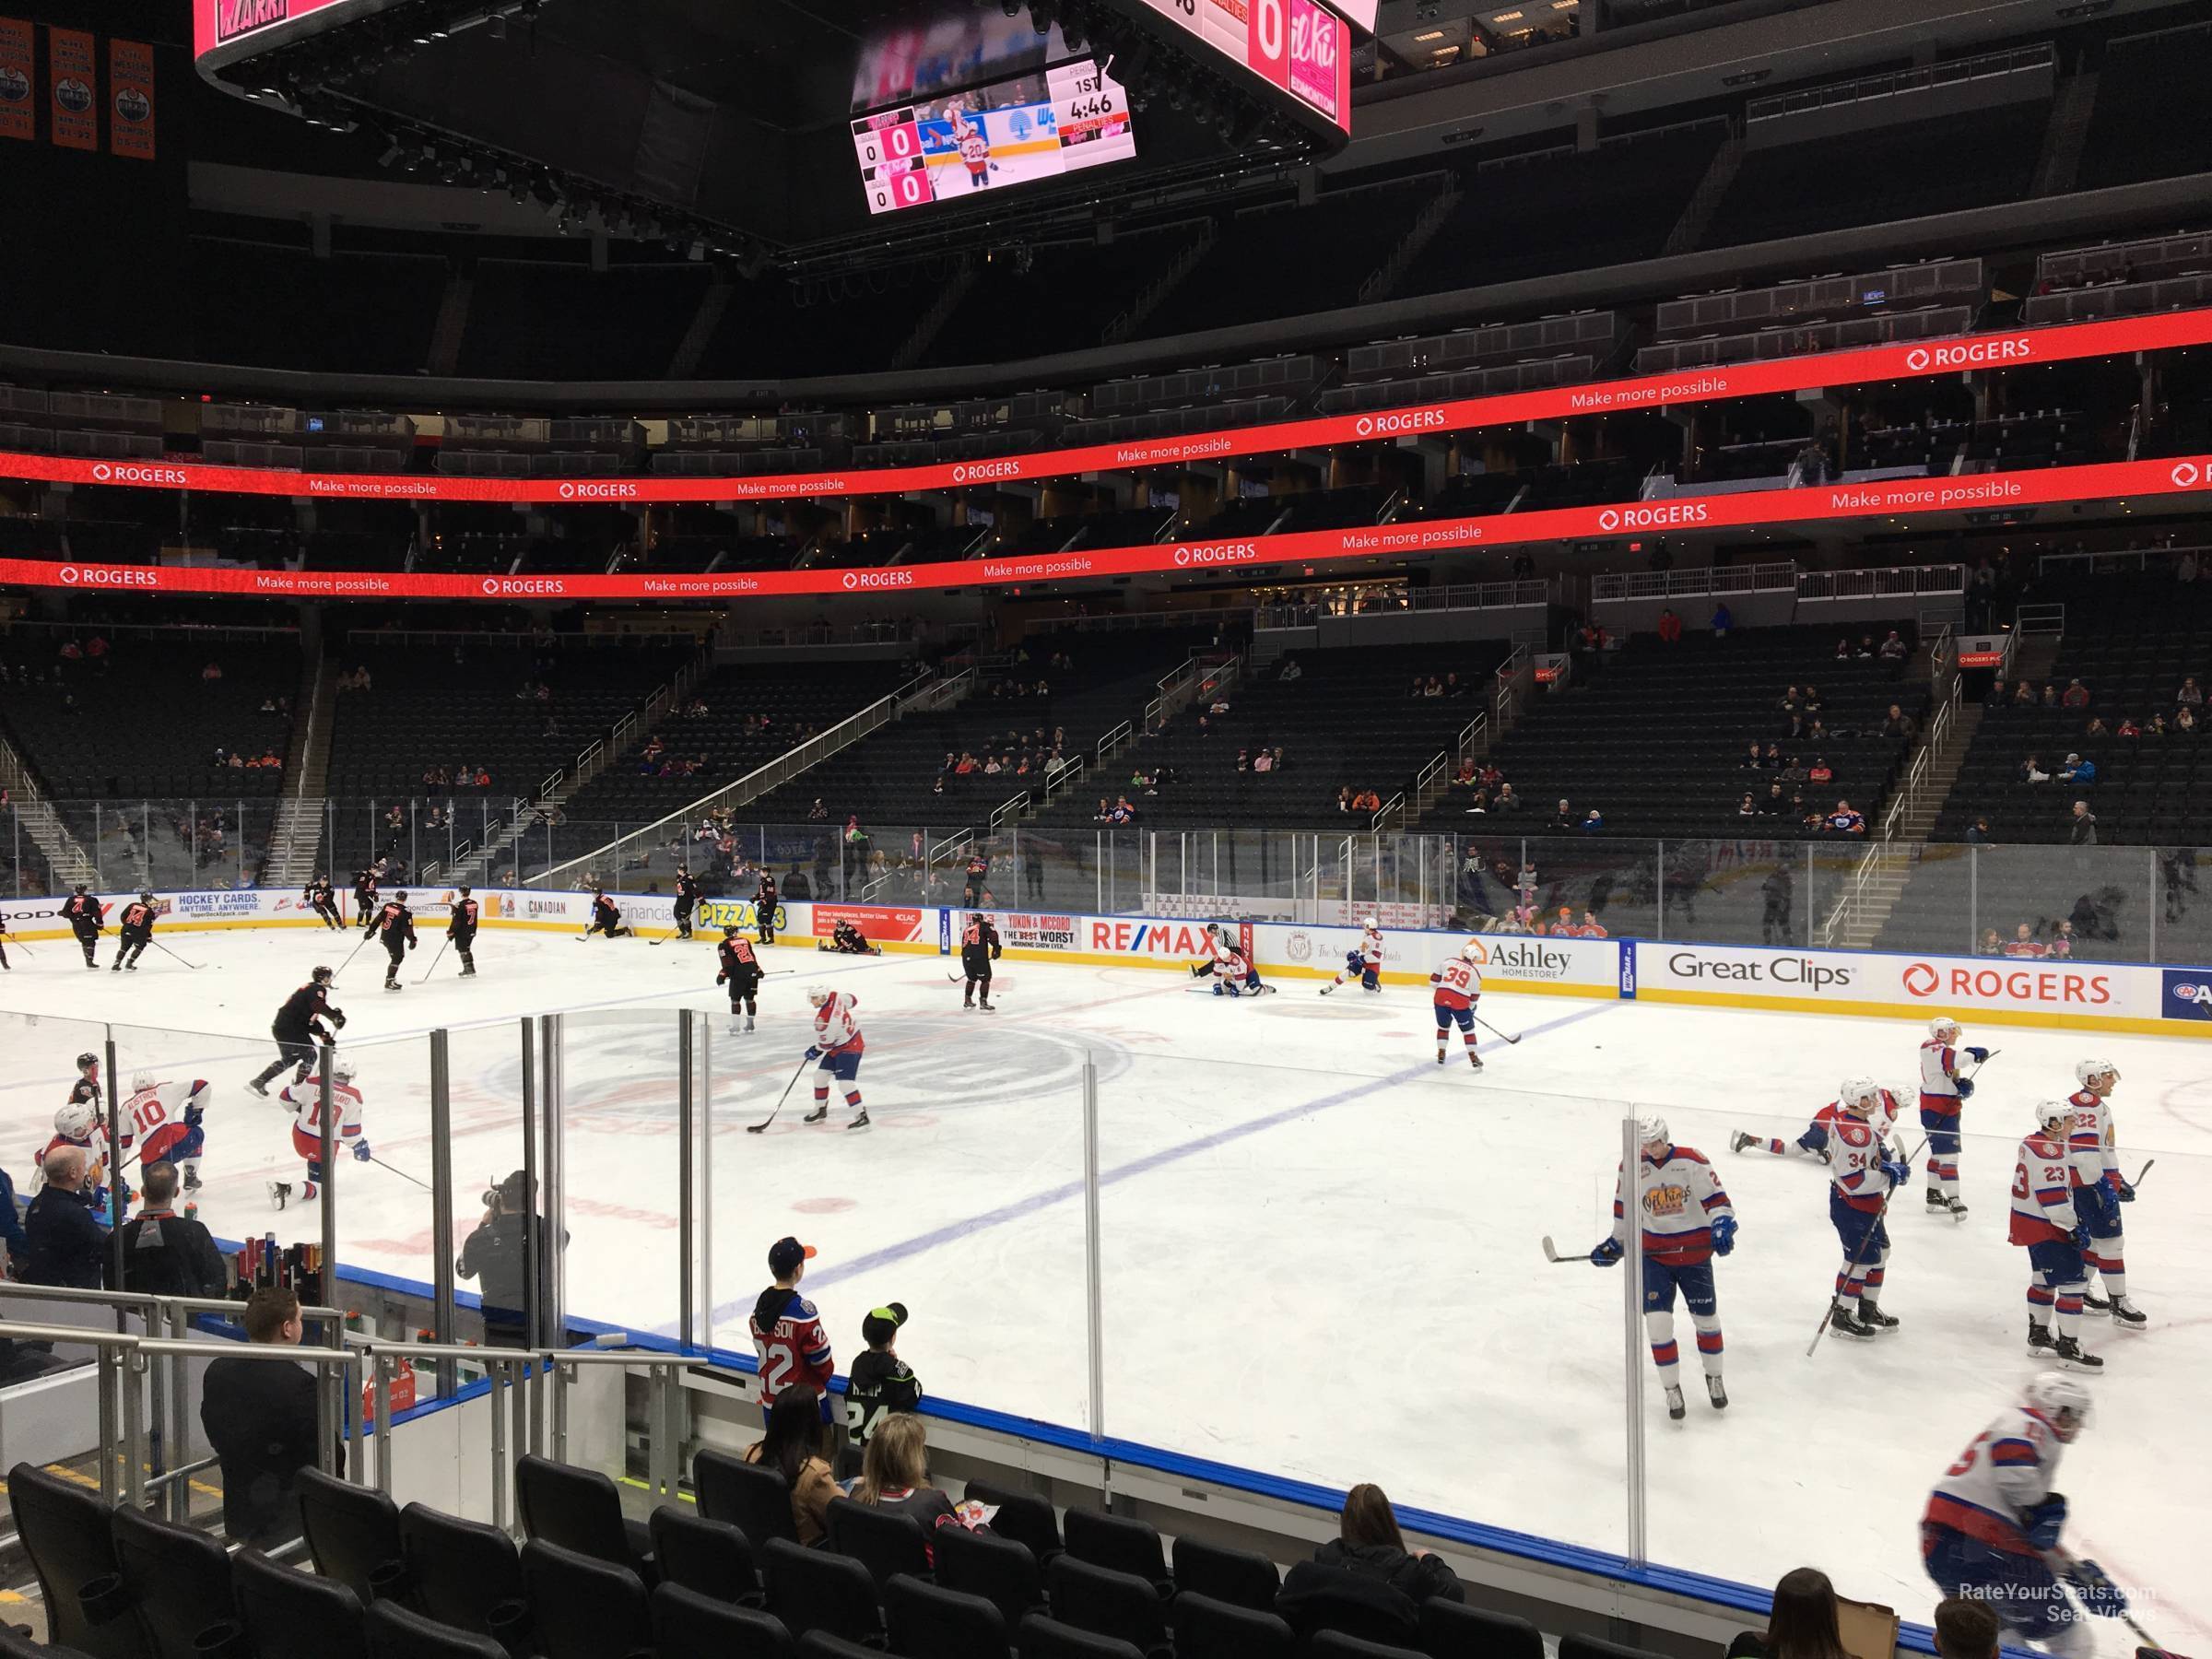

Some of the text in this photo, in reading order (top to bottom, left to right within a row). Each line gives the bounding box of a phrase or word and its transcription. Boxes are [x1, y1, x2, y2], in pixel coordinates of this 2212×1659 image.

[1076, 76, 1099, 93] 1ST
[1292, 75, 1335, 115] EDMONTON
[1071, 94, 1112, 119] 4:46
[1073, 117, 1114, 131] PENALTIES
[892, 129, 910, 155] 0
[866, 146, 876, 161] 0
[902, 176, 920, 202] 0
[877, 192, 886, 206] 0
[1936, 338, 2030, 366] ROGERS
[1571, 378, 1727, 408] Make more possible
[1377, 409, 1444, 431] ROGERS
[1118, 438, 1231, 462] Make more possible
[115, 466, 186, 483] ROGERS
[968, 461, 1019, 479] ROGERS
[310, 480, 437, 498] Make more possible
[577, 484, 637, 496] ROGERS
[737, 479, 844, 495] Make more possible
[1832, 479, 2022, 508] Make more possible
[1624, 504, 1707, 527] ROGERS
[1342, 525, 1482, 548] Make more possible
[1193, 544, 1255, 562] ROGERS
[983, 558, 1092, 577] Make more possible
[83, 569, 157, 585] ROGERS
[257, 577, 390, 593] Make more possible
[860, 571, 912, 587] ROGERS
[503, 580, 563, 593] ROGERS
[645, 579, 758, 594] Make more possible
[72, 902, 83, 913] 4
[179, 894, 261, 905] HOCKEY CARDS.
[529, 900, 566, 914] CANADIAN
[126, 908, 146, 927] 14
[382, 913, 394, 930] 5
[467, 908, 475, 925] 7
[699, 903, 758, 929] PIZZA
[1008, 914, 1071, 931] YUKON & MCCORD
[1004, 931, 1074, 943] THE BEST WORST
[1093, 923, 1217, 956] RE/MAX
[1489, 942, 1571, 975] Ashley
[1443, 966, 1471, 988] 39
[1502, 968, 1558, 979] HOMESTORE
[1669, 953, 1851, 992] Great Clips
[1951, 968, 2110, 1004] ROGERS
[134, 1100, 166, 1135] 10
[2074, 1113, 2097, 1129] 22
[1849, 1153, 1867, 1168] 34
[2044, 1166, 2065, 1182] 23
